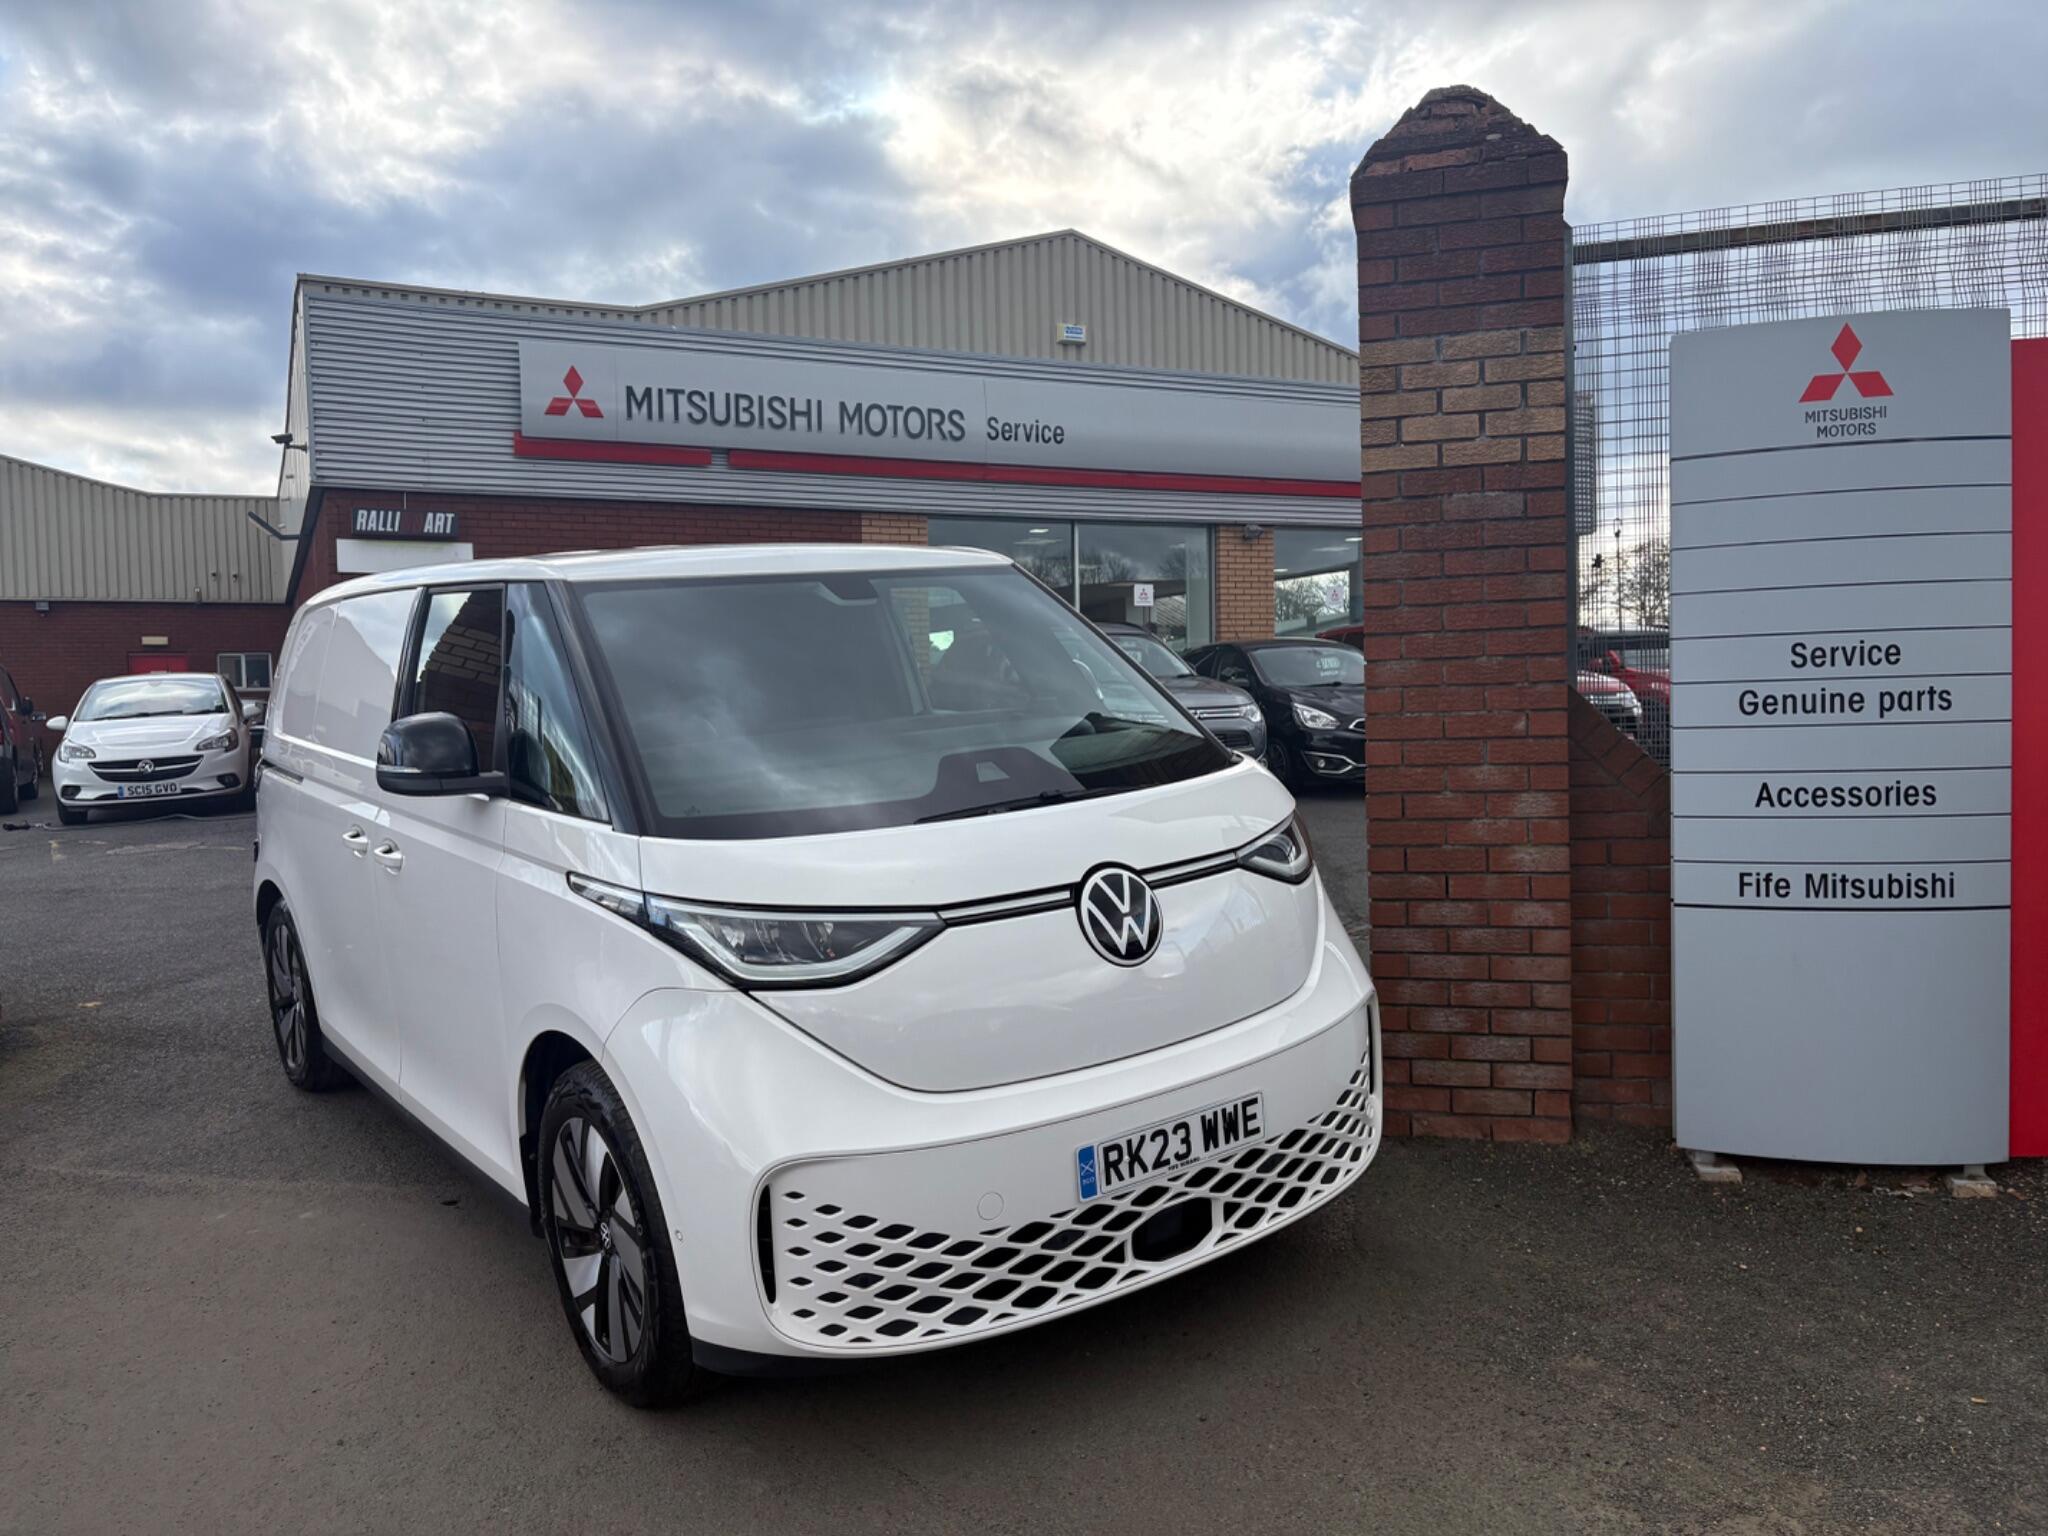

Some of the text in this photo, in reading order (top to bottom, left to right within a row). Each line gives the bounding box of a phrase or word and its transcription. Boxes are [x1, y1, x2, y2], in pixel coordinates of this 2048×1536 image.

[626, 384, 1065, 445] MITSUBISHI MOTORS Service
[1804, 405, 1888, 424] MITSUBISHI
[1816, 422, 1877, 439] MOTORS
[355, 509, 455, 534] RALLI ART
[1790, 640, 1902, 669] Service
[1738, 684, 1954, 719] Genuine parts
[1754, 780, 1938, 808] Accessories
[1738, 872, 1956, 900] Fife Mitsubishi
[1102, 1096, 1261, 1186] RK23 WWE
